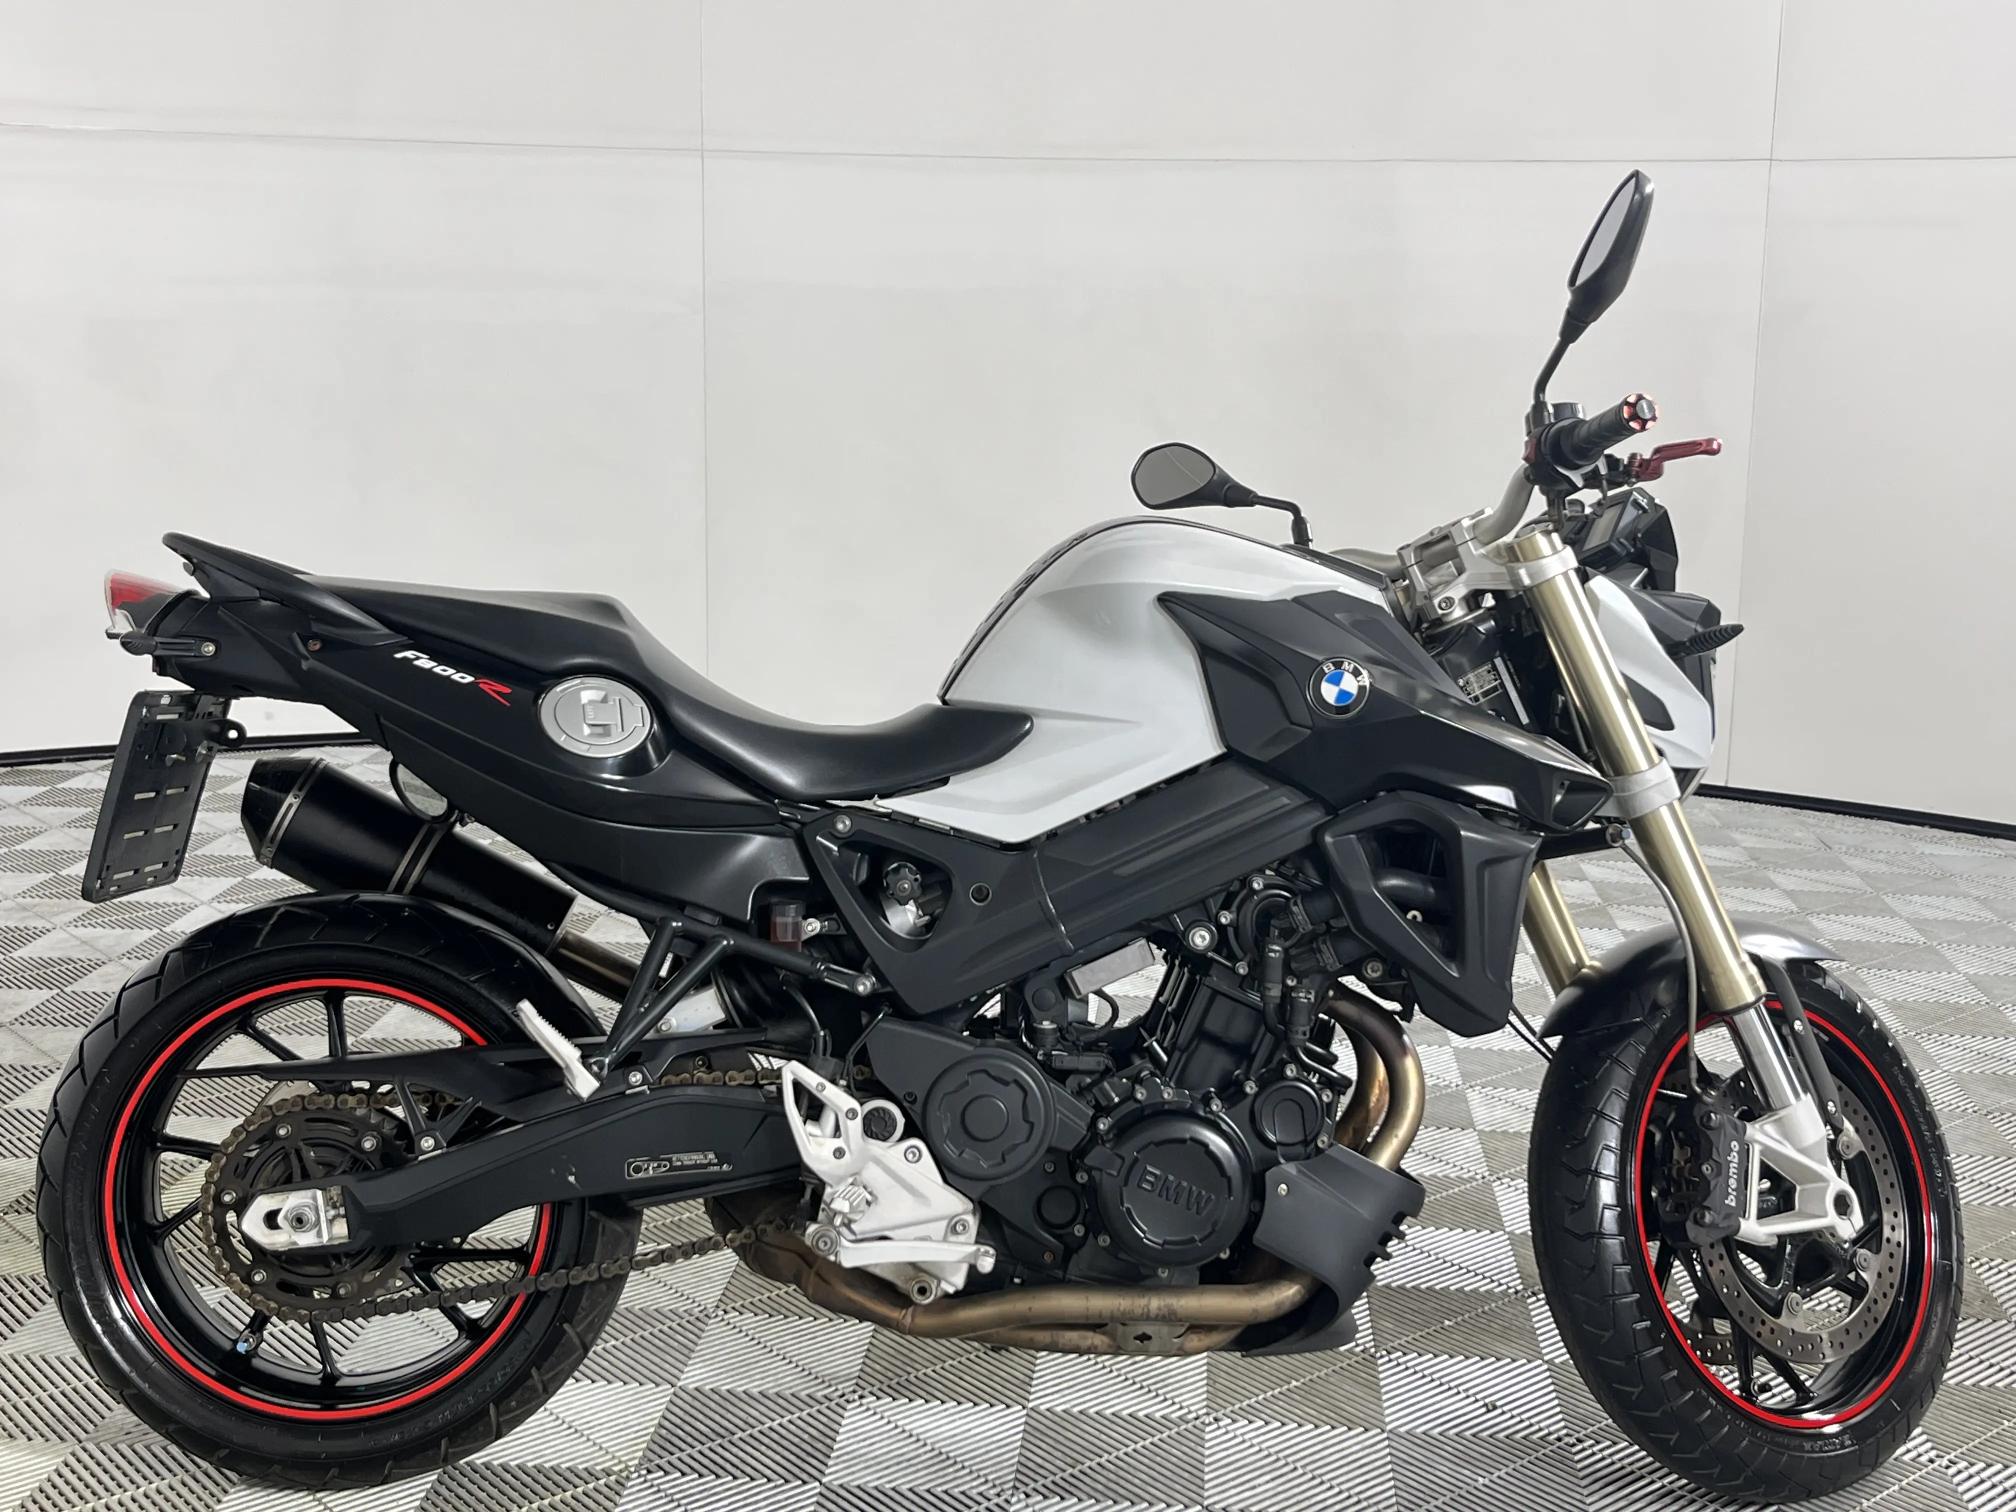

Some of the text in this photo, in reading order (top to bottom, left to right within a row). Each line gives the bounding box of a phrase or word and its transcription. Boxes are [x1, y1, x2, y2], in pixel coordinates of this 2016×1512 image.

[1322, 661, 1370, 686] BMW
[1137, 1164, 1215, 1216] BMW
[1725, 1140, 1739, 1207] brembo
